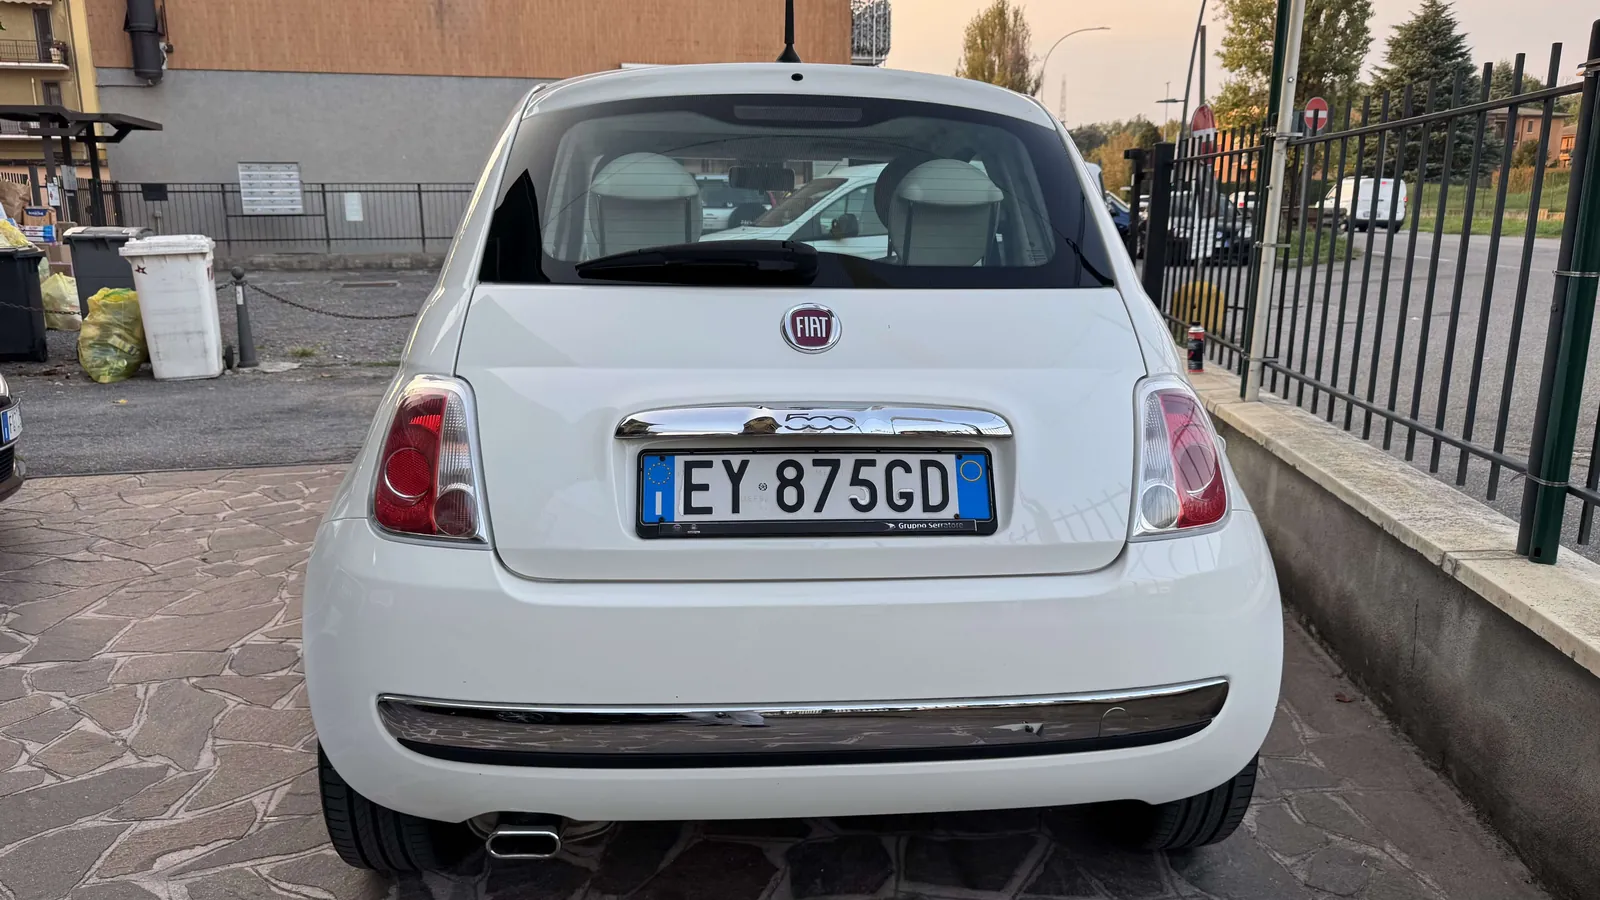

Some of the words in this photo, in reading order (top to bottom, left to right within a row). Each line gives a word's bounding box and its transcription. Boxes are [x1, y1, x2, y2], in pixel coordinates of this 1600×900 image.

[796, 316, 828, 338] FIAT
[785, 413, 854, 431] 500
[683, 459, 750, 515] EY
[776, 458, 950, 513] 875GD
[655, 491, 662, 515] I
[898, 522, 927, 530] Gruppo
